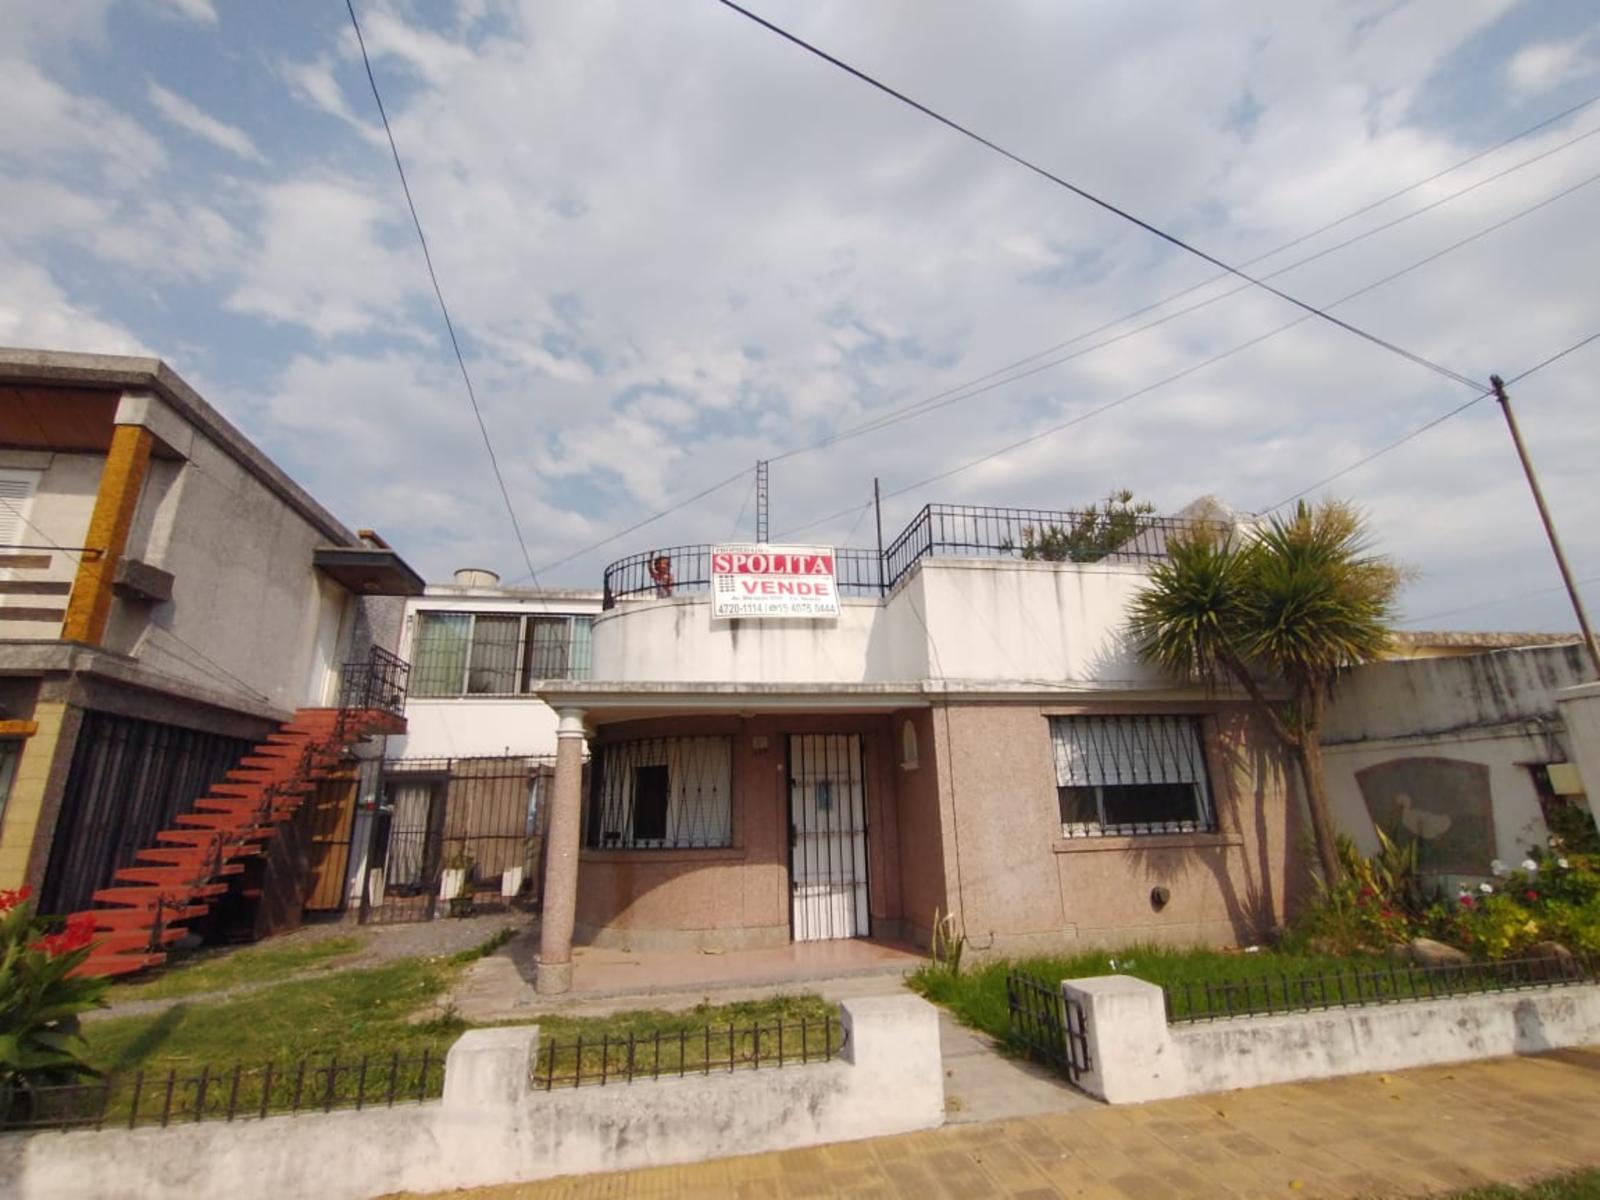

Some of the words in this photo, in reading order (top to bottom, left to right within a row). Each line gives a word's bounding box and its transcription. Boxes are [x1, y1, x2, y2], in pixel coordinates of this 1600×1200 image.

[715, 554, 829, 574] SPOLITA
[741, 580, 830, 596] VENDE
[718, 603, 763, 614] 4720-1114
